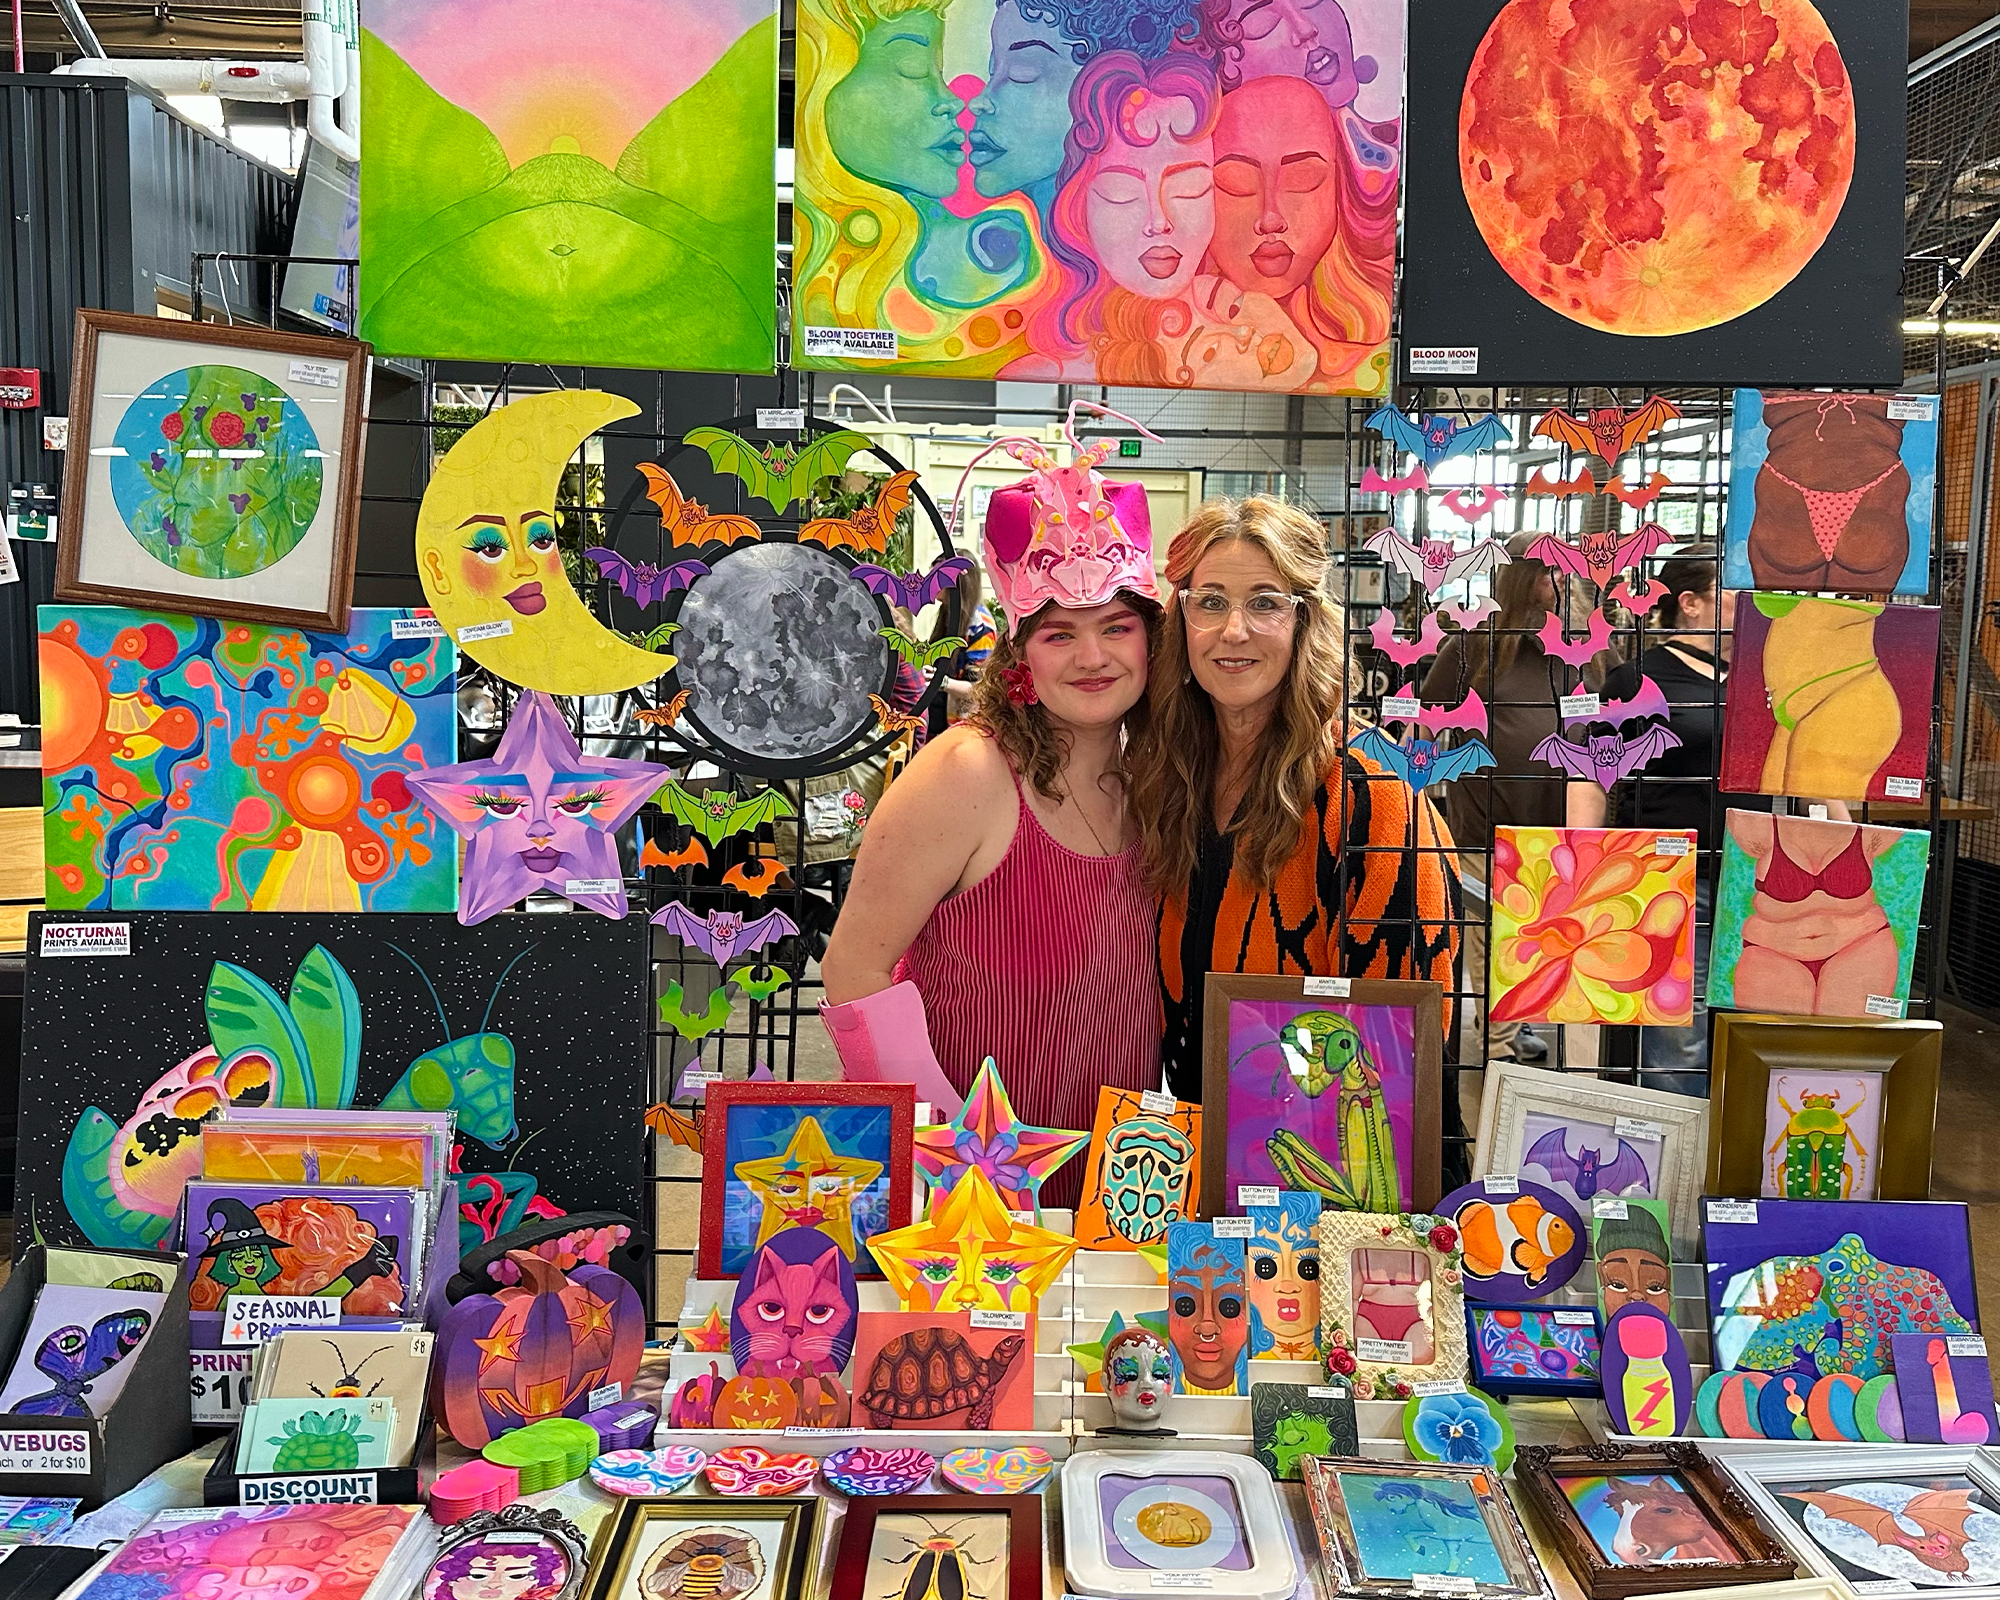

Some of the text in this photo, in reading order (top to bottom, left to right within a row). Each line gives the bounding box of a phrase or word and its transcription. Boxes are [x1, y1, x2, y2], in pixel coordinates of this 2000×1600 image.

[808, 330, 894, 340] BLOOM TOGETHER
[808, 338, 895, 349] PRINTS AVAILABLE
[395, 621, 419, 629] TIDAL
[46, 926, 128, 939] NOCTURNAL
[44, 938, 128, 947] PRINTS AVAILABLE
[233, 1300, 337, 1321] SEASONAL
[982, 1312, 1015, 1320] "SLOWPOKE"
[414, 1338, 426, 1354] $8
[371, 1401, 383, 1415] $4
[41, 1457, 48, 1467] 2
[50, 1457, 64, 1468] for
[66, 1457, 86, 1469] $10
[244, 1477, 372, 1500] DISCOUNT
